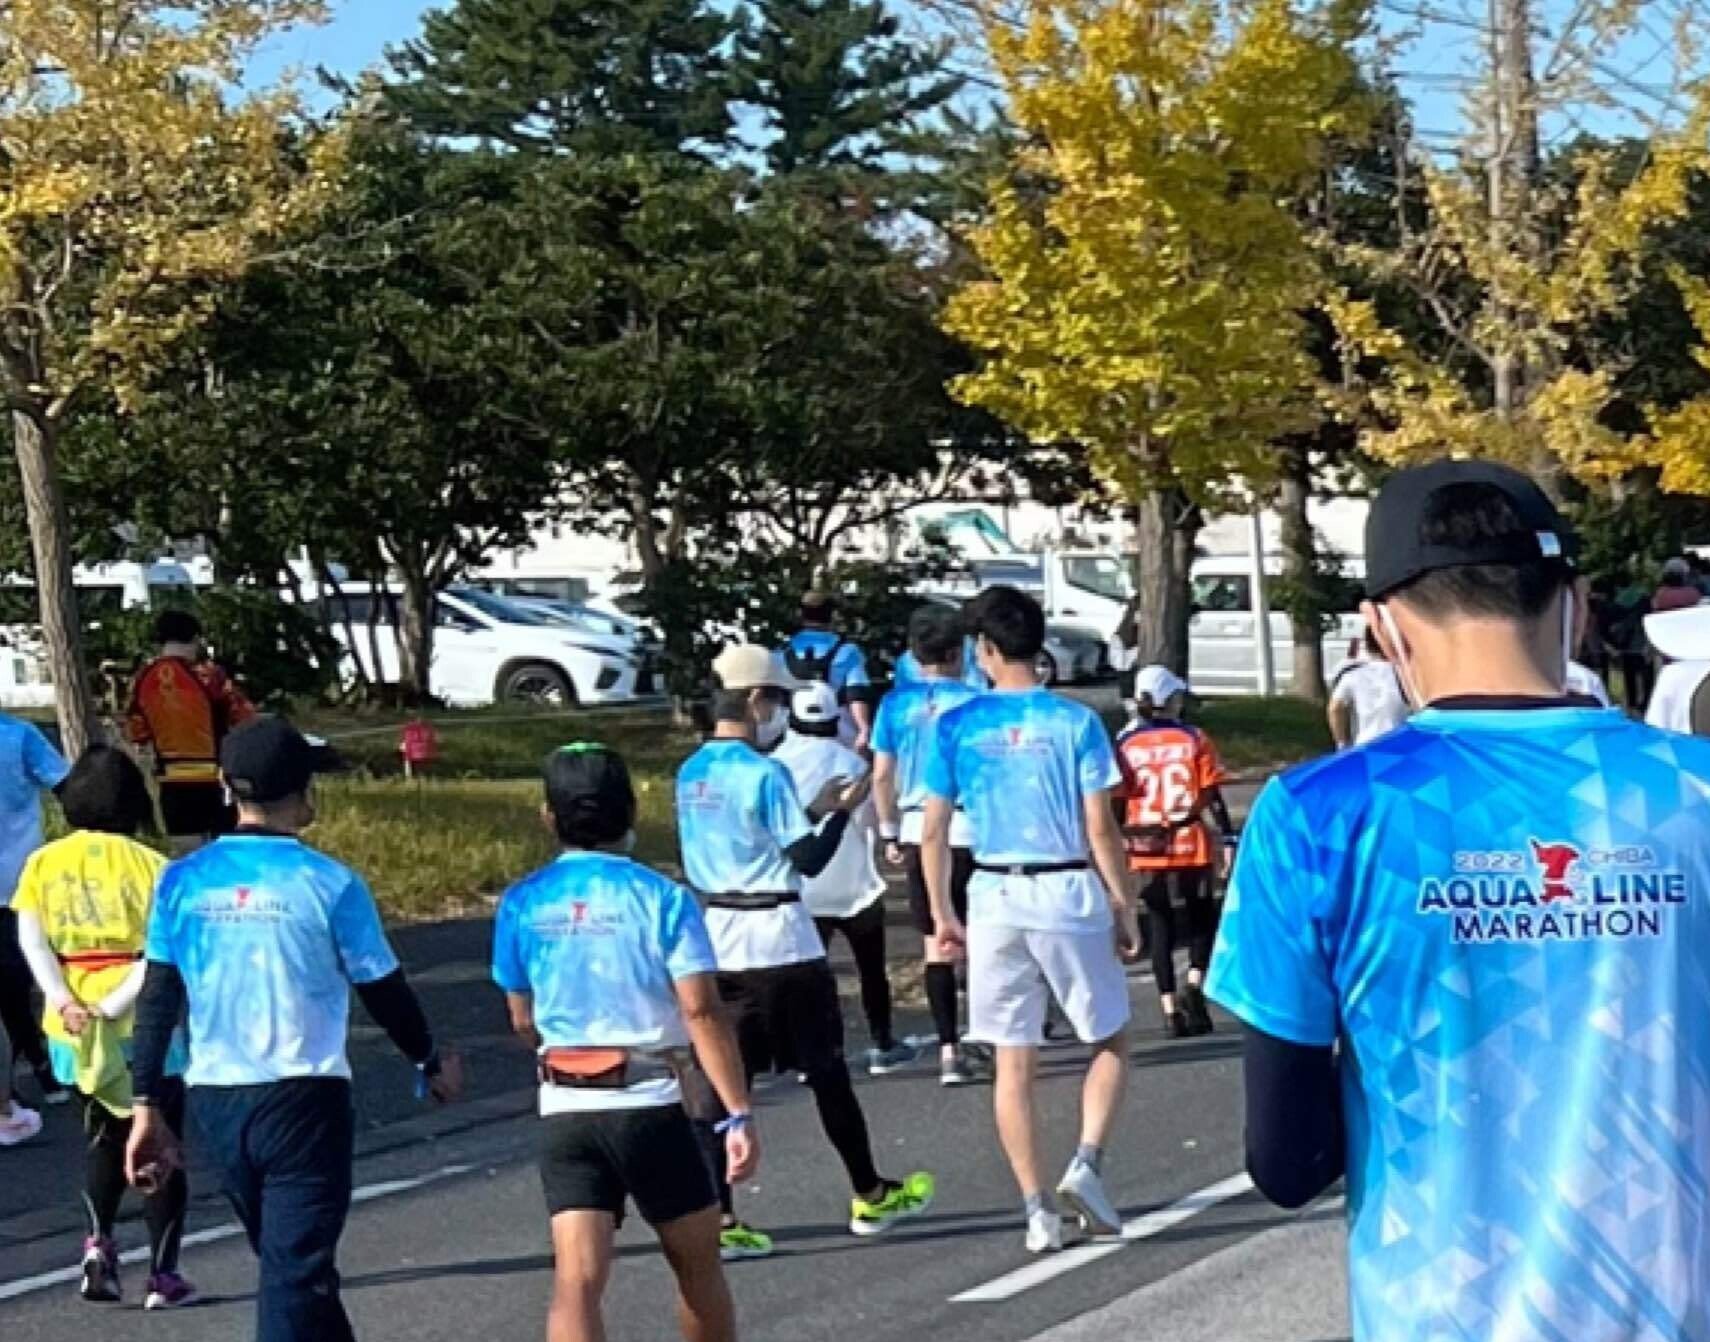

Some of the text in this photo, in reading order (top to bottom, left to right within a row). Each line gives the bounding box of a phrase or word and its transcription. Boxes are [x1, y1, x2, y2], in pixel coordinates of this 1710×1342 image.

[1455, 853, 1523, 868] 2022
[1420, 874, 1686, 909] AQUA LINE
[1454, 910, 1661, 940] MARATHON
